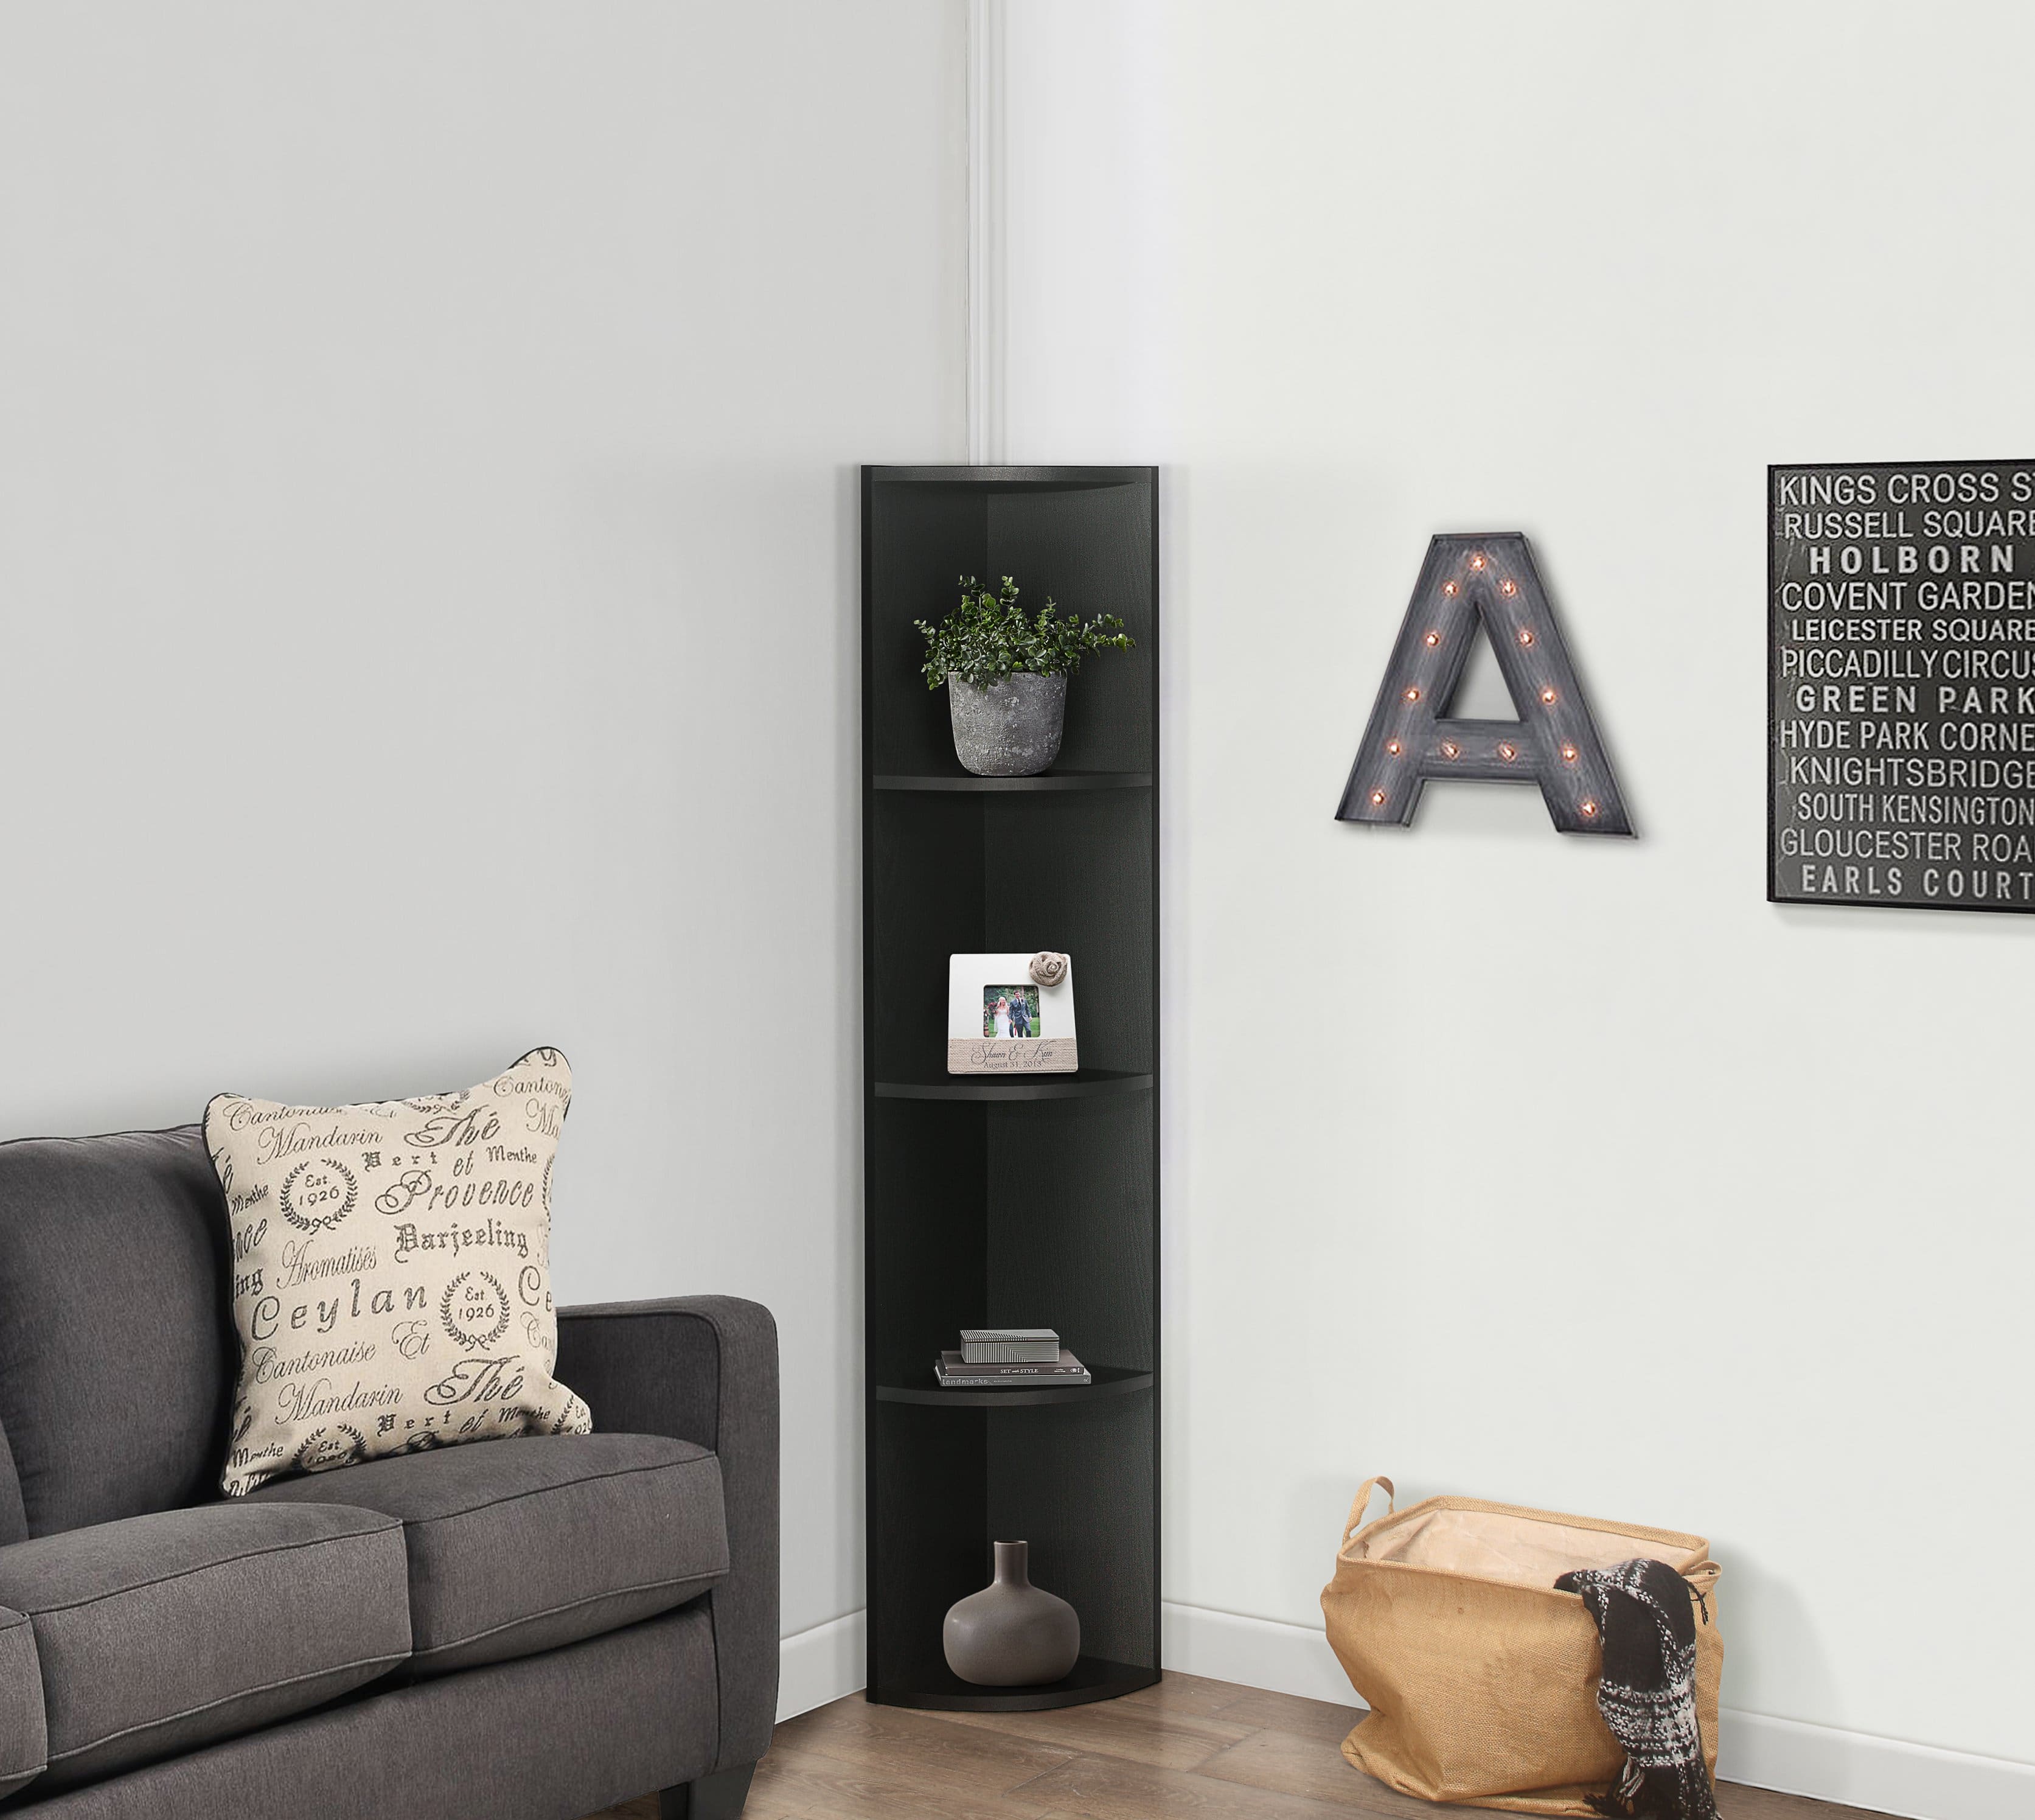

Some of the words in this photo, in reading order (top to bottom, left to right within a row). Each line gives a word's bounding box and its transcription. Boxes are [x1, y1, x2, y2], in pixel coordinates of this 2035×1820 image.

[1780, 475, 1876, 505] KINGS
[1887, 472, 1999, 504] CROSS
[2011, 472, 2035, 502] S
[1784, 511, 1913, 539] RUSSELL
[1809, 545, 2014, 574] HOLBORN
[1781, 581, 1908, 611] COVENT
[1792, 618, 1923, 641] LEICESTER
[1932, 618, 2035, 641] SQUARE
[1781, 649, 1938, 678] PICCADILLY
[1943, 649, 2035, 679] CIRCU
[1335, 531, 1638, 839] A
[1796, 684, 1916, 713] GREEN
[1939, 686, 2035, 714] PARK
[1779, 719, 1851, 749] HYDE
[1860, 721, 1930, 750] PARK
[1797, 791, 1874, 823] SOUTH
[1882, 795, 2034, 826] KENSINGTON
[1779, 828, 1961, 861] GLOUCESTER
[1973, 832, 2035, 863] ROA
[1802, 864, 1903, 895] EARLS
[1924, 869, 2034, 900] COURT
[984, 1061, 1008, 1070] August
[257, 1123, 384, 1165] Mandarin
[453, 1150, 475, 1177] et
[486, 1145, 538, 1164] Menthe
[231, 1184, 270, 1217] Menthe
[299, 1186, 340, 1207] 1926
[375, 1169, 534, 1215] Provence
[394, 1218, 529, 1263] Darjeeling
[251, 1278, 427, 1341] Ceylan
[459, 1304, 495, 1322] 1926
[252, 1341, 377, 1384] Cantonaise
[274, 1378, 404, 1424] Mandarin
